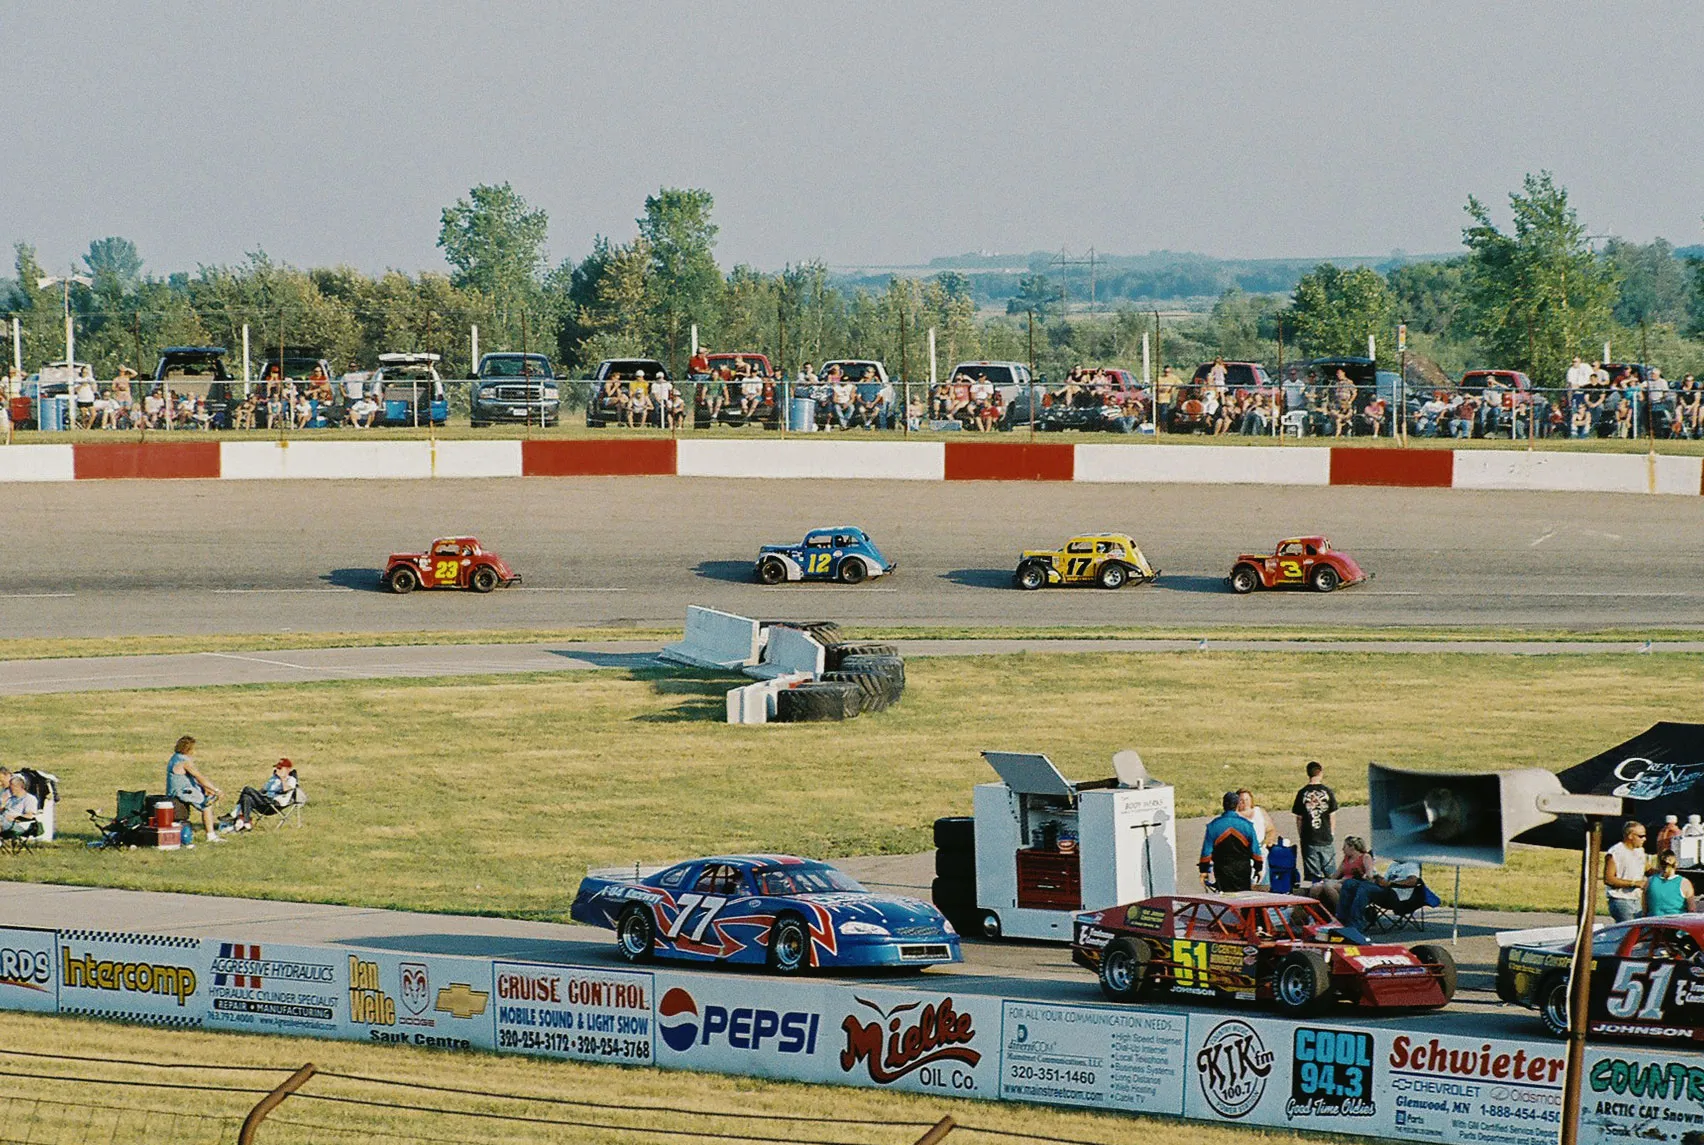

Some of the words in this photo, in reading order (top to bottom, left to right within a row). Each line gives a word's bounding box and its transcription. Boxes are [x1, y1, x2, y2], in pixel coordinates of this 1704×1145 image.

[434, 560, 459, 579] 23
[807, 553, 832, 573] 12
[1066, 557, 1092, 576] 17
[1280, 560, 1303, 577] 3
[667, 893, 727, 941] 77
[210, 958, 270, 976] AGGRESSIVE
[271, 963, 334, 981] HYDRAULICS
[348, 954, 379, 990] Dan
[1172, 939, 1210, 988] 51
[62, 946, 196, 1006] Intercomp
[208, 987, 254, 1000] HYDRAULIC
[256, 990, 296, 1003] CYLINDER
[298, 994, 339, 1007] SPECIALIST
[498, 974, 562, 1003] CRUISE
[568, 978, 650, 1010] CONTROL
[1170, 985, 1216, 996] JOHNSON
[1606, 960, 1677, 1020] 51
[218, 1000, 248, 1011] REPAIR
[256, 1004, 330, 1019] MANUFACTURING
[349, 988, 396, 1026] Welle
[399, 1017, 435, 1028] DODGE
[499, 1006, 536, 1026] MOBILE
[539, 1009, 574, 1029] SOUND
[577, 1012, 584, 1030] &
[587, 1012, 615, 1032] LIGHT
[617, 1015, 649, 1035] SHOW
[1009, 1007, 1023, 1019] FOR
[1025, 1009, 1040, 1021] ALL
[1040, 1010, 1062, 1022] YOUR
[1064, 1012, 1142, 1028] COMMUNICATION
[370, 1029, 409, 1044] Sauk
[414, 1033, 470, 1049] Centre
[701, 1005, 820, 1054] PEPSI
[1115, 1033, 1131, 1043] High
[1133, 1033, 1154, 1044] Speed
[1592, 1023, 1694, 1037] JOHNSON
[499, 1029, 569, 1052] 320-254-3172
[577, 1035, 650, 1059] 320-254-3768
[840, 997, 979, 1084] Mielke
[1295, 1029, 1371, 1067] COOL
[1115, 1053, 1133, 1062] Local
[1197, 1034, 1271, 1090] KIK
[1254, 1050, 1275, 1067] fm
[919, 1066, 947, 1088] OIL
[952, 1069, 978, 1090] Co.
[1011, 1065, 1096, 1084] 320-351-1460
[1115, 1062, 1145, 1073] Business
[1146, 1065, 1174, 1076] Systems
[1115, 1073, 1131, 1083] Long
[1301, 1062, 1363, 1098] 94.3
[1221, 1081, 1253, 1100] 100.7
[1413, 1080, 1481, 1098] CHEVROLET
[1510, 1089, 1562, 1106] Oldsmob
[1286, 1096, 1313, 1120] Good
[1313, 1098, 1340, 1116] Time
[1340, 1097, 1376, 1117] Oldies
[1396, 1095, 1450, 1114] Glenwood,
[1452, 1101, 1471, 1114] MN
[1595, 1100, 1635, 1117] ARCTIC
[1638, 1103, 1660, 1119] CAT
[1407, 1114, 1424, 1124] Parts
[1460, 1131, 1477, 1140] Parts
[1510, 1125, 1534, 1135] Service
